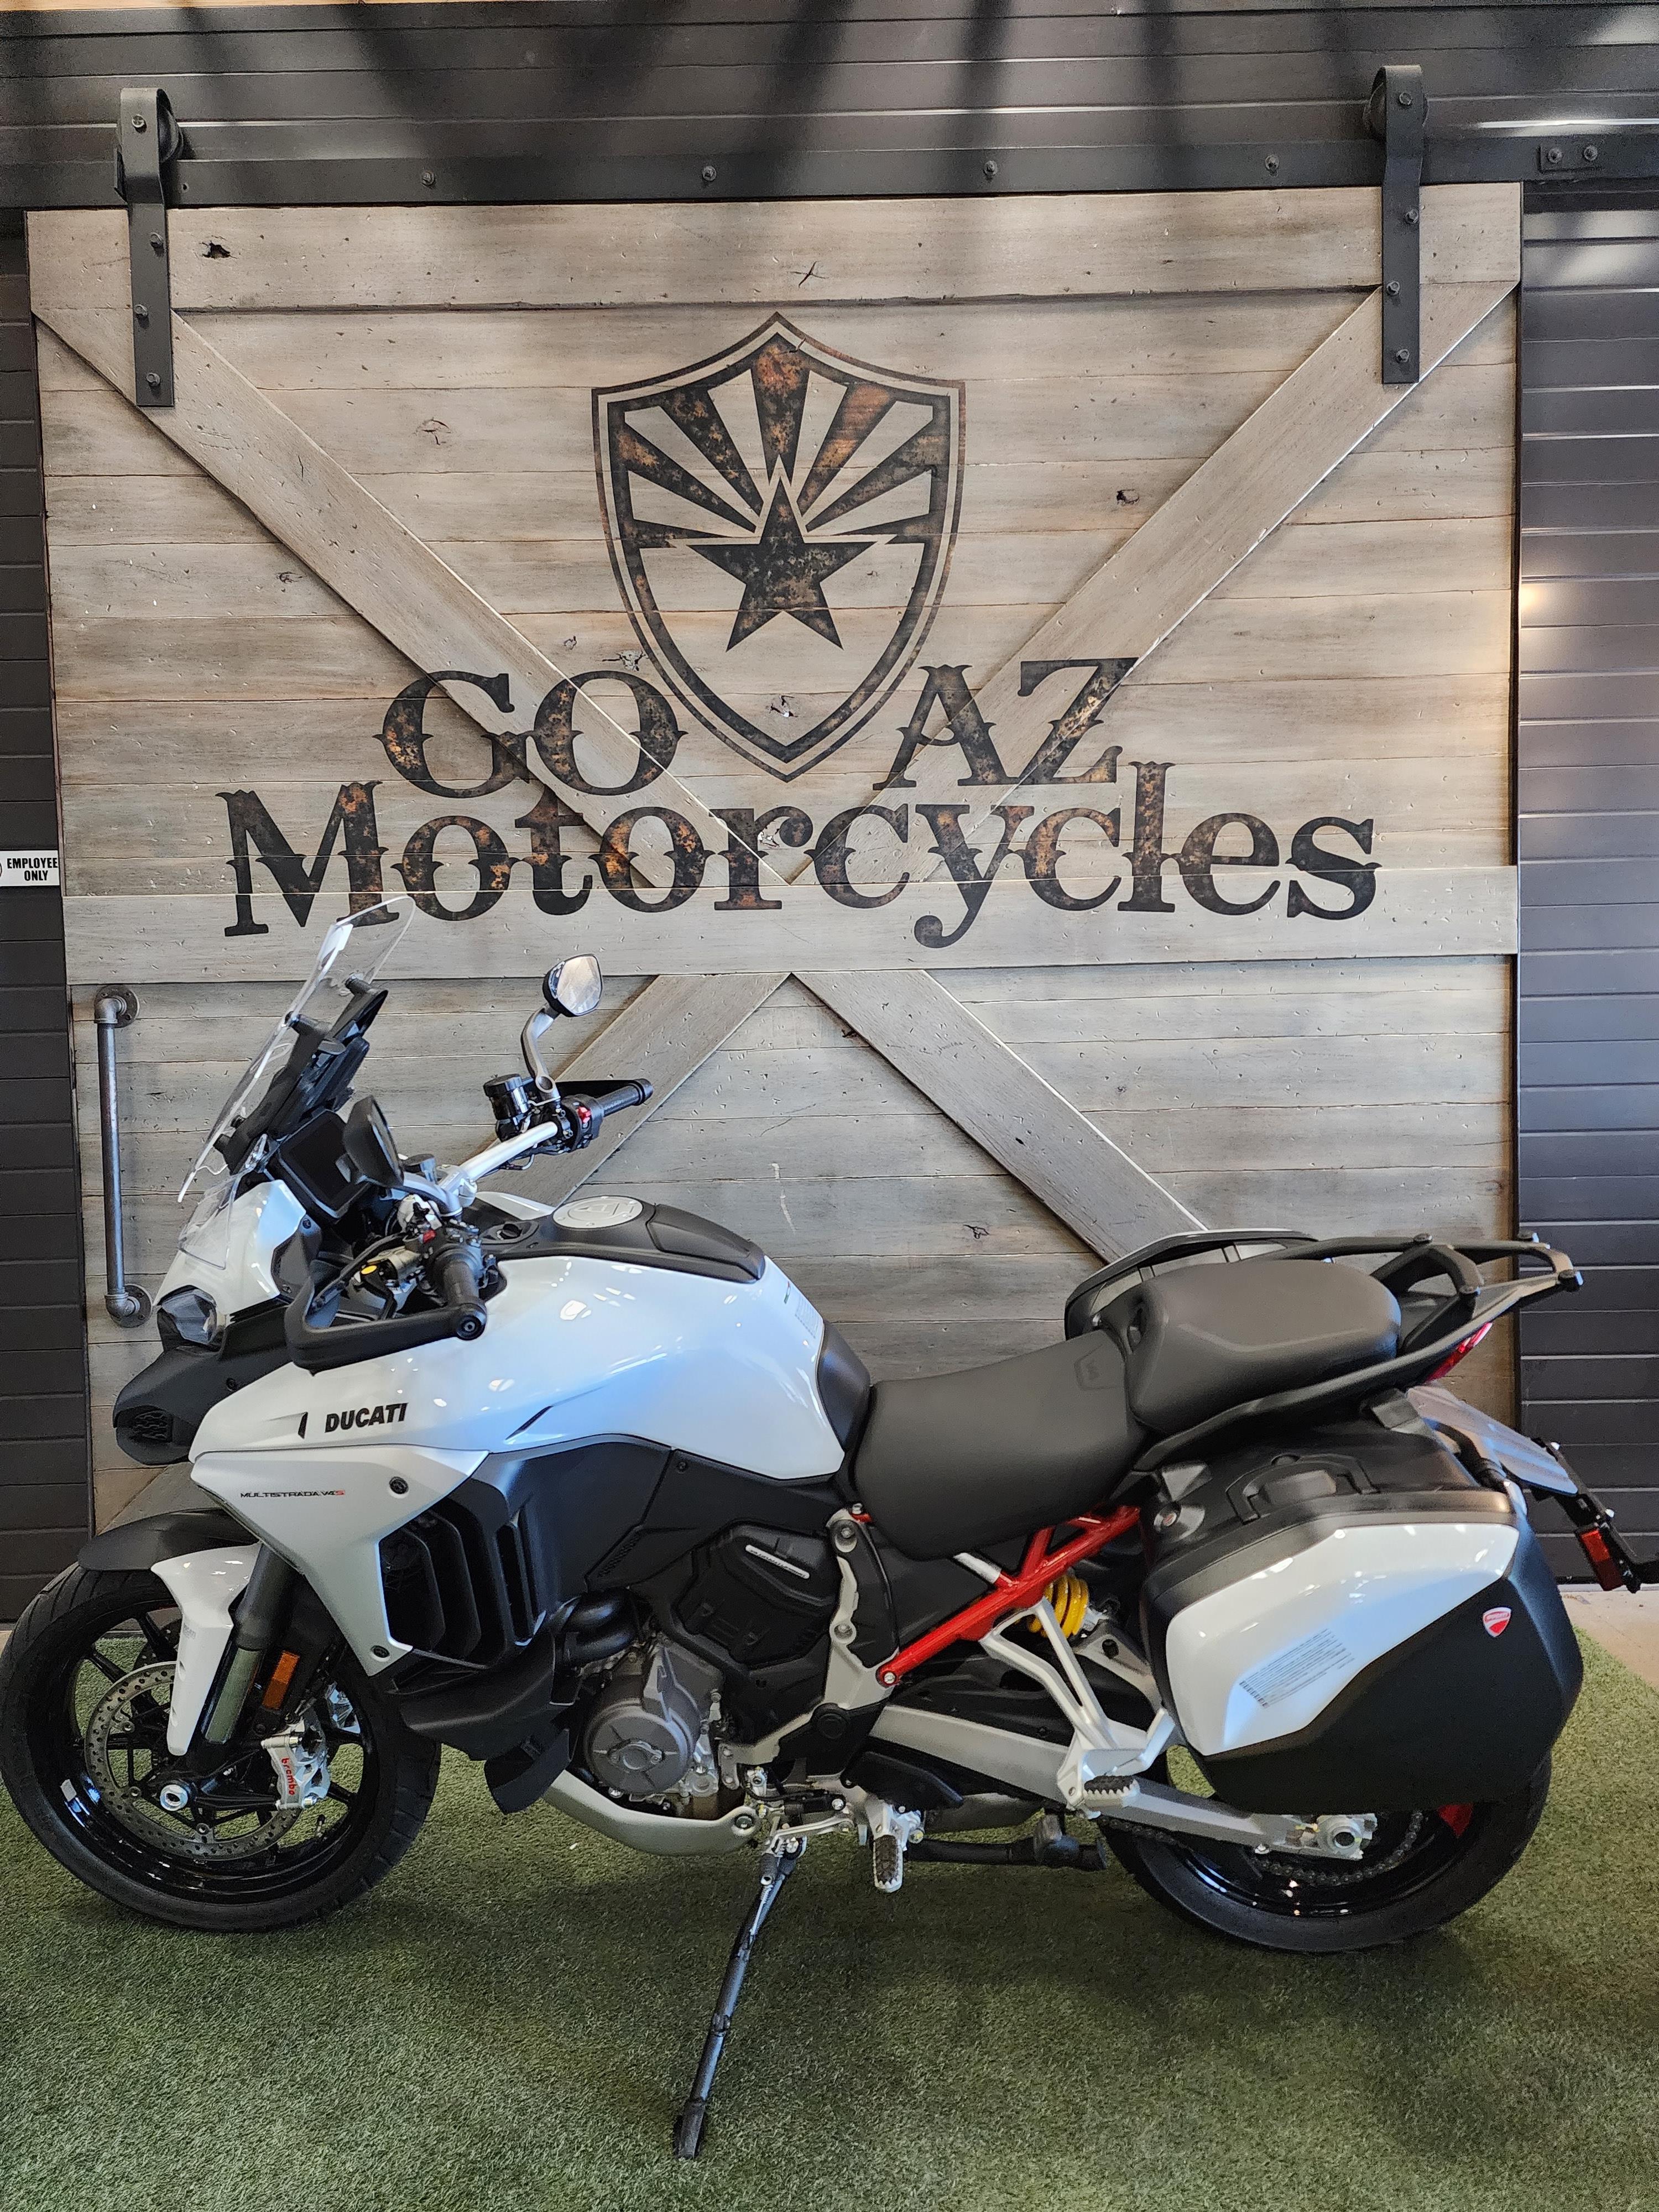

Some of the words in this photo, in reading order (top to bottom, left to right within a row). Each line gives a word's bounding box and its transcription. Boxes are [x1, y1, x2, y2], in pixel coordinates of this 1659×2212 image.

[372, 670, 688, 798] GO
[873, 657, 1139, 790] AZ
[7, 857, 58, 869] EMPLOYEE
[216, 760, 1383, 948] Motorcycles
[24, 870, 49, 881] ONLY
[325, 1402, 409, 1433] DUCATI
[281, 1757, 298, 1796] brembo
